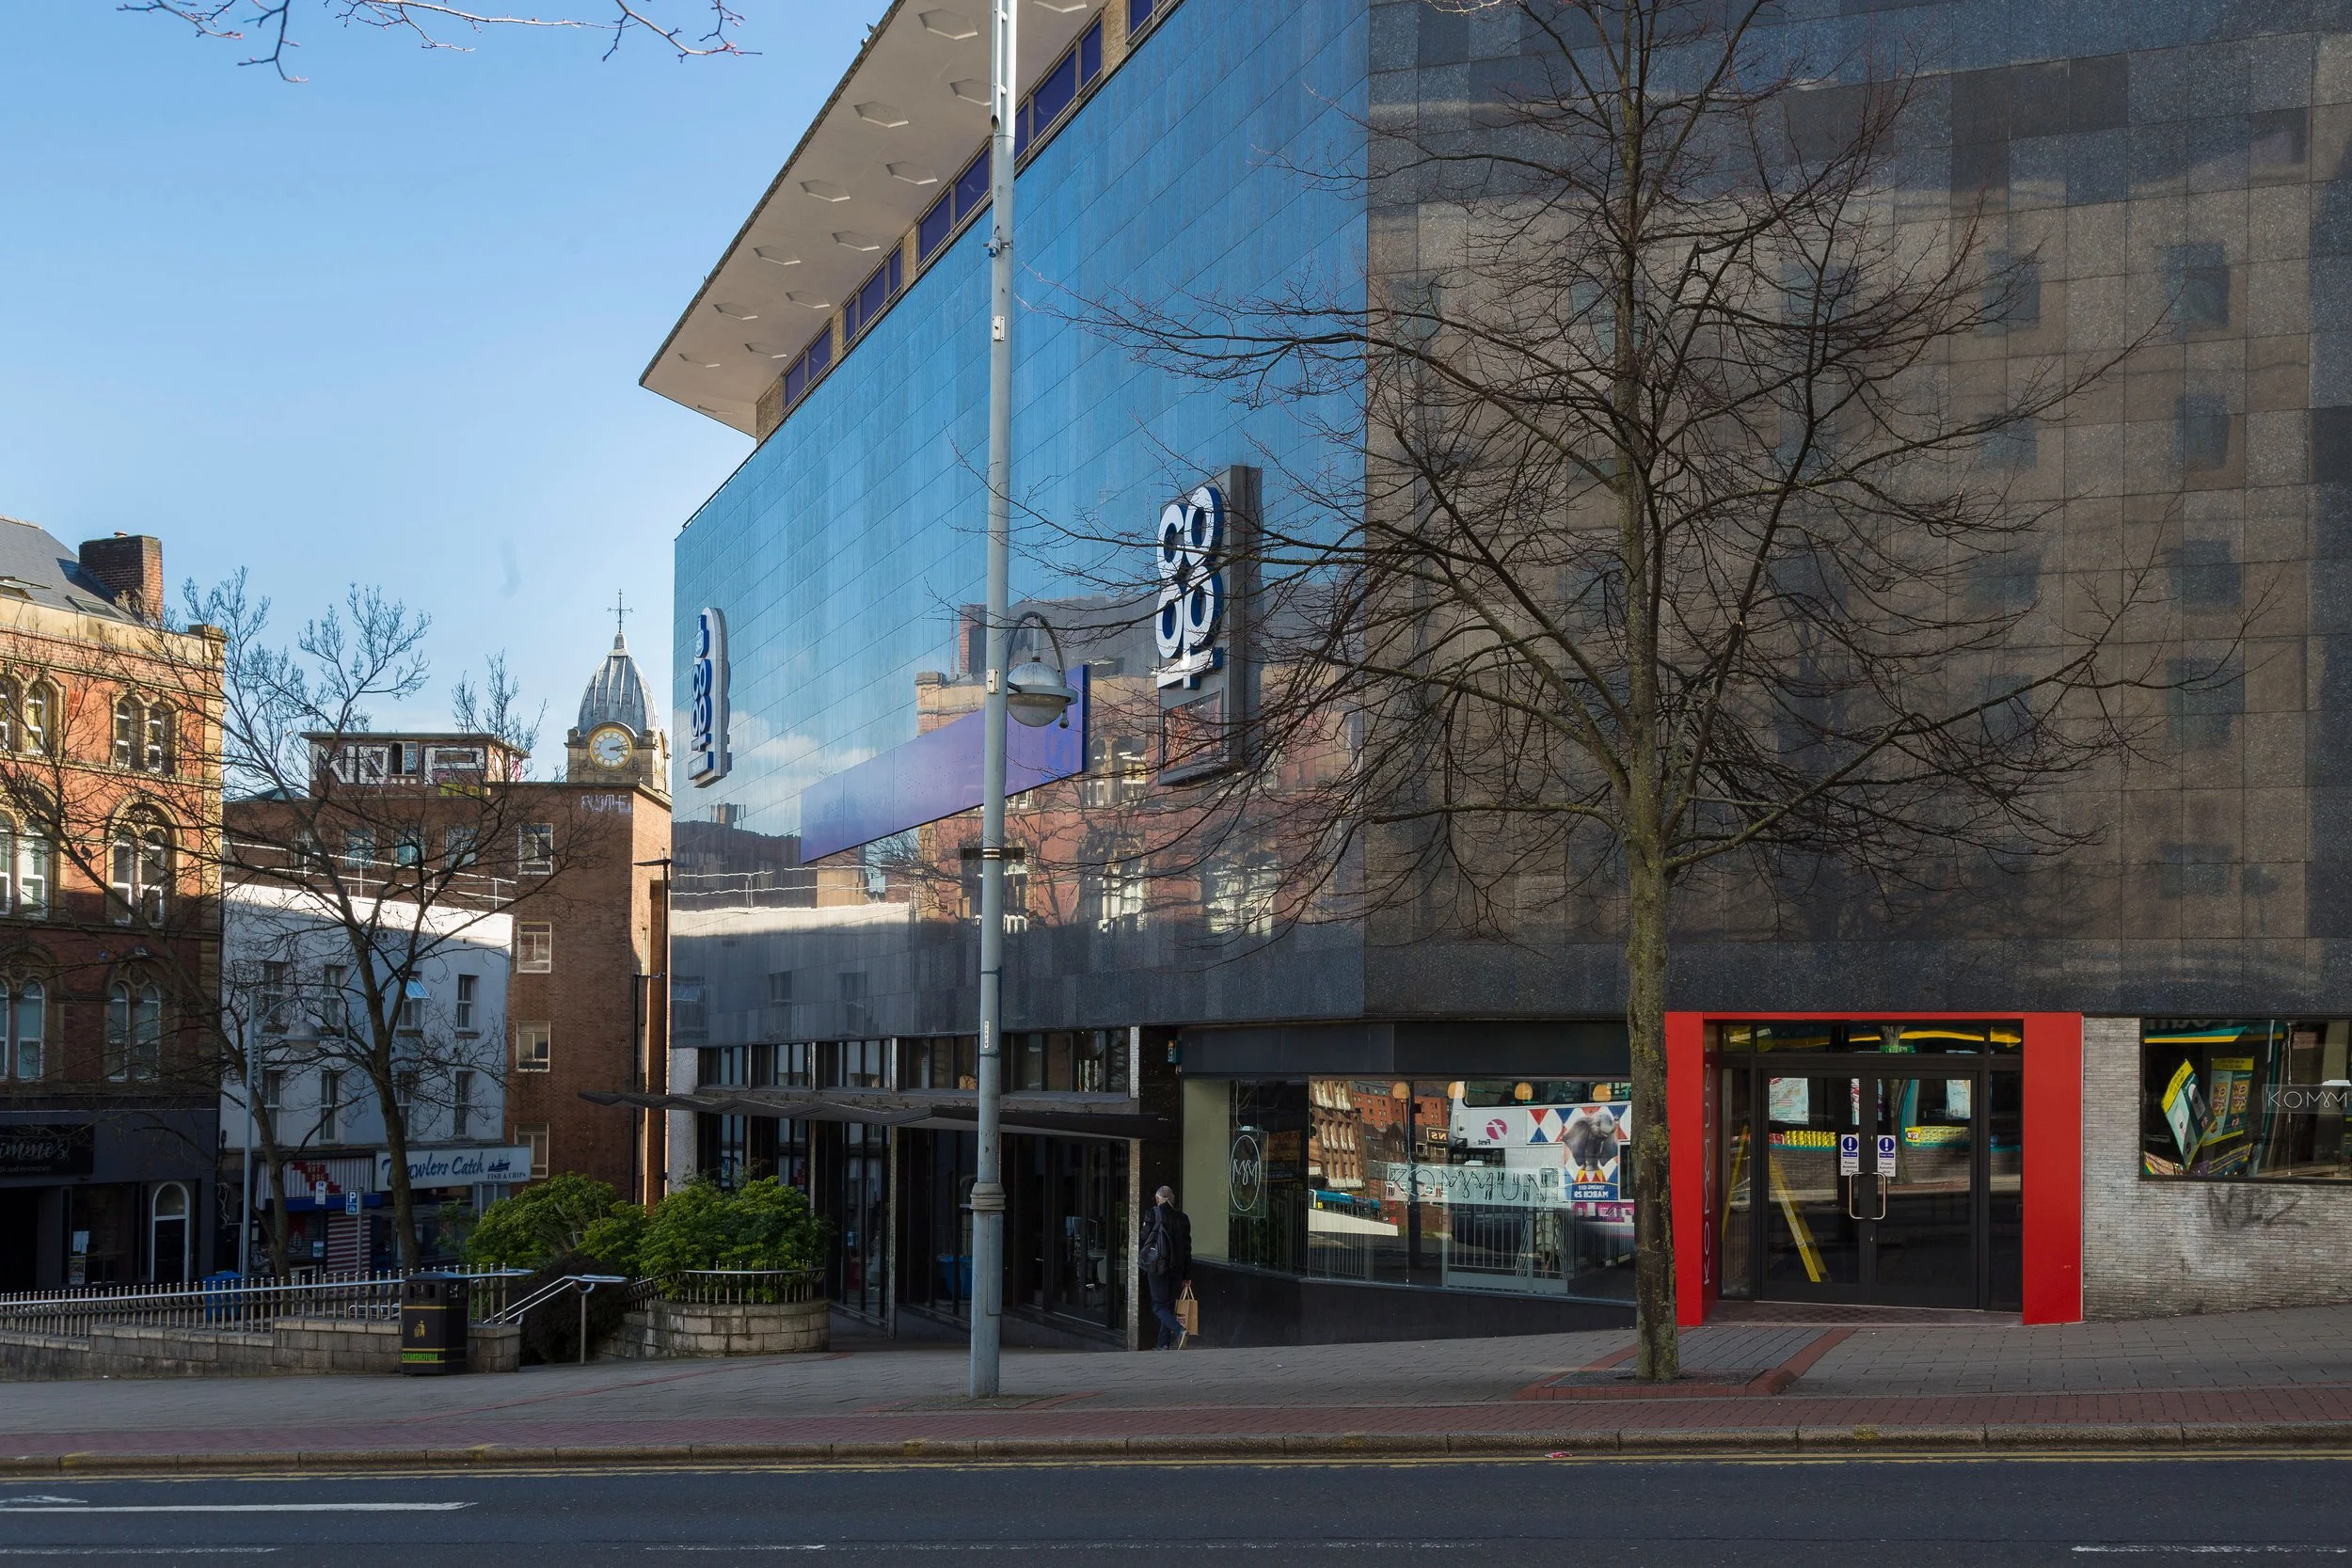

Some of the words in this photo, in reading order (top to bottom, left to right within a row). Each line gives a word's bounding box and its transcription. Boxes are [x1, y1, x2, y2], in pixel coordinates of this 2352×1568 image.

[382, 1151, 449, 1186] Tawlers
[452, 1150, 485, 1176] Catch
[349, 1191, 357, 1203] P
